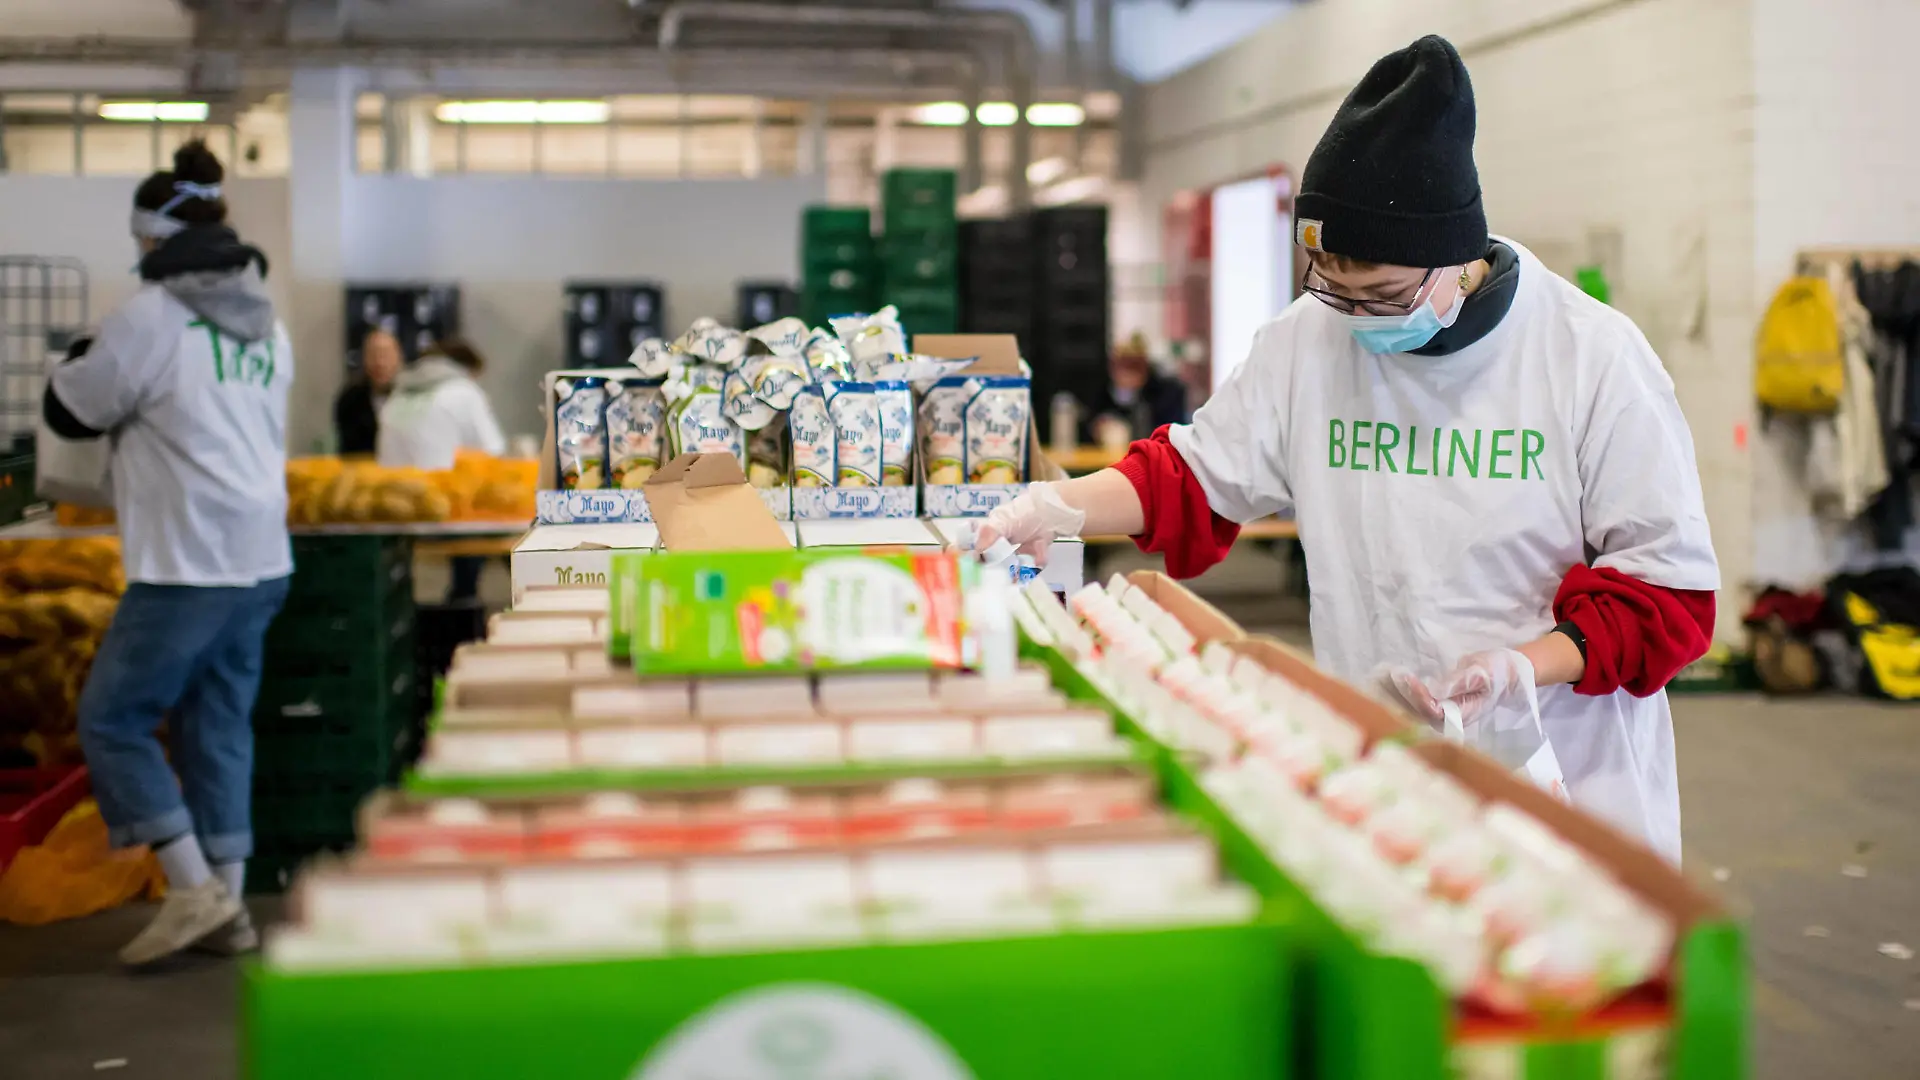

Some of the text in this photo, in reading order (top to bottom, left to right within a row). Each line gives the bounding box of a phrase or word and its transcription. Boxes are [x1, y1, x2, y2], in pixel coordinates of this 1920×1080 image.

[698, 423, 729, 441] Mayo
[883, 427, 900, 443] ayo
[1328, 418, 1545, 481] BERLINER
[580, 496, 615, 516] Mayo
[835, 491, 869, 512] Mayo
[967, 490, 1001, 512] Mayo
